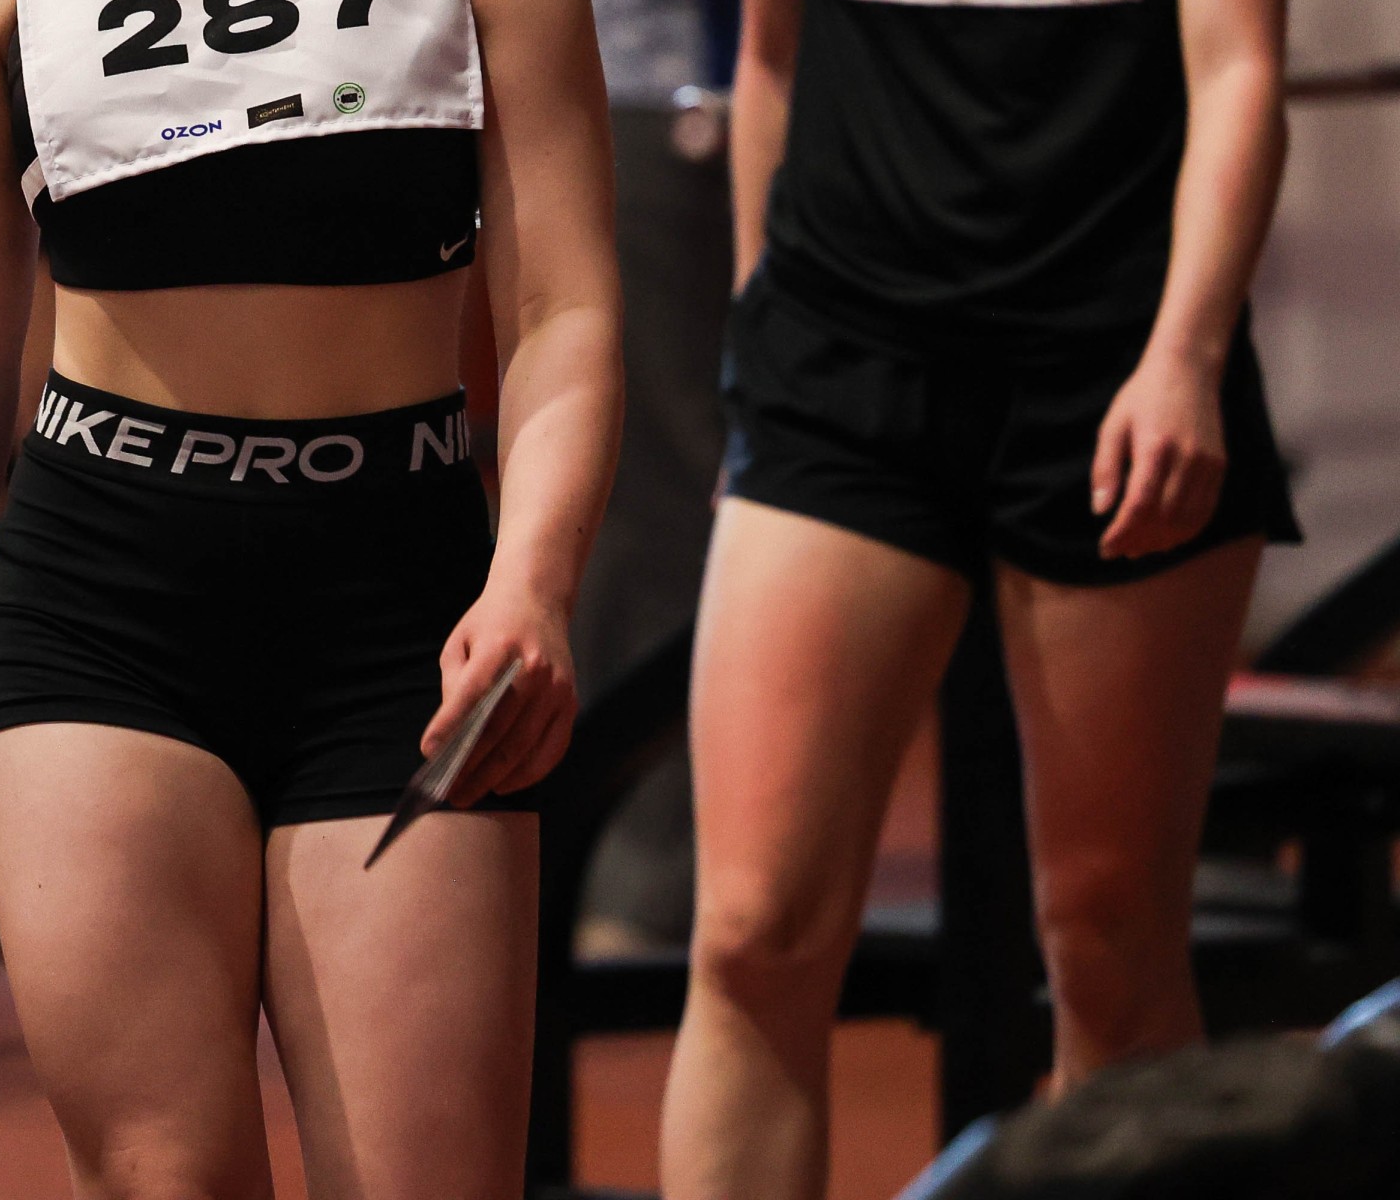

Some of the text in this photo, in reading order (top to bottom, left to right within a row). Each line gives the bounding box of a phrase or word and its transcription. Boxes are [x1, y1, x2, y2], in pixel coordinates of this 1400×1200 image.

[161, 120, 222, 140] OZON
[34, 382, 469, 483] NIKE PRO NI
